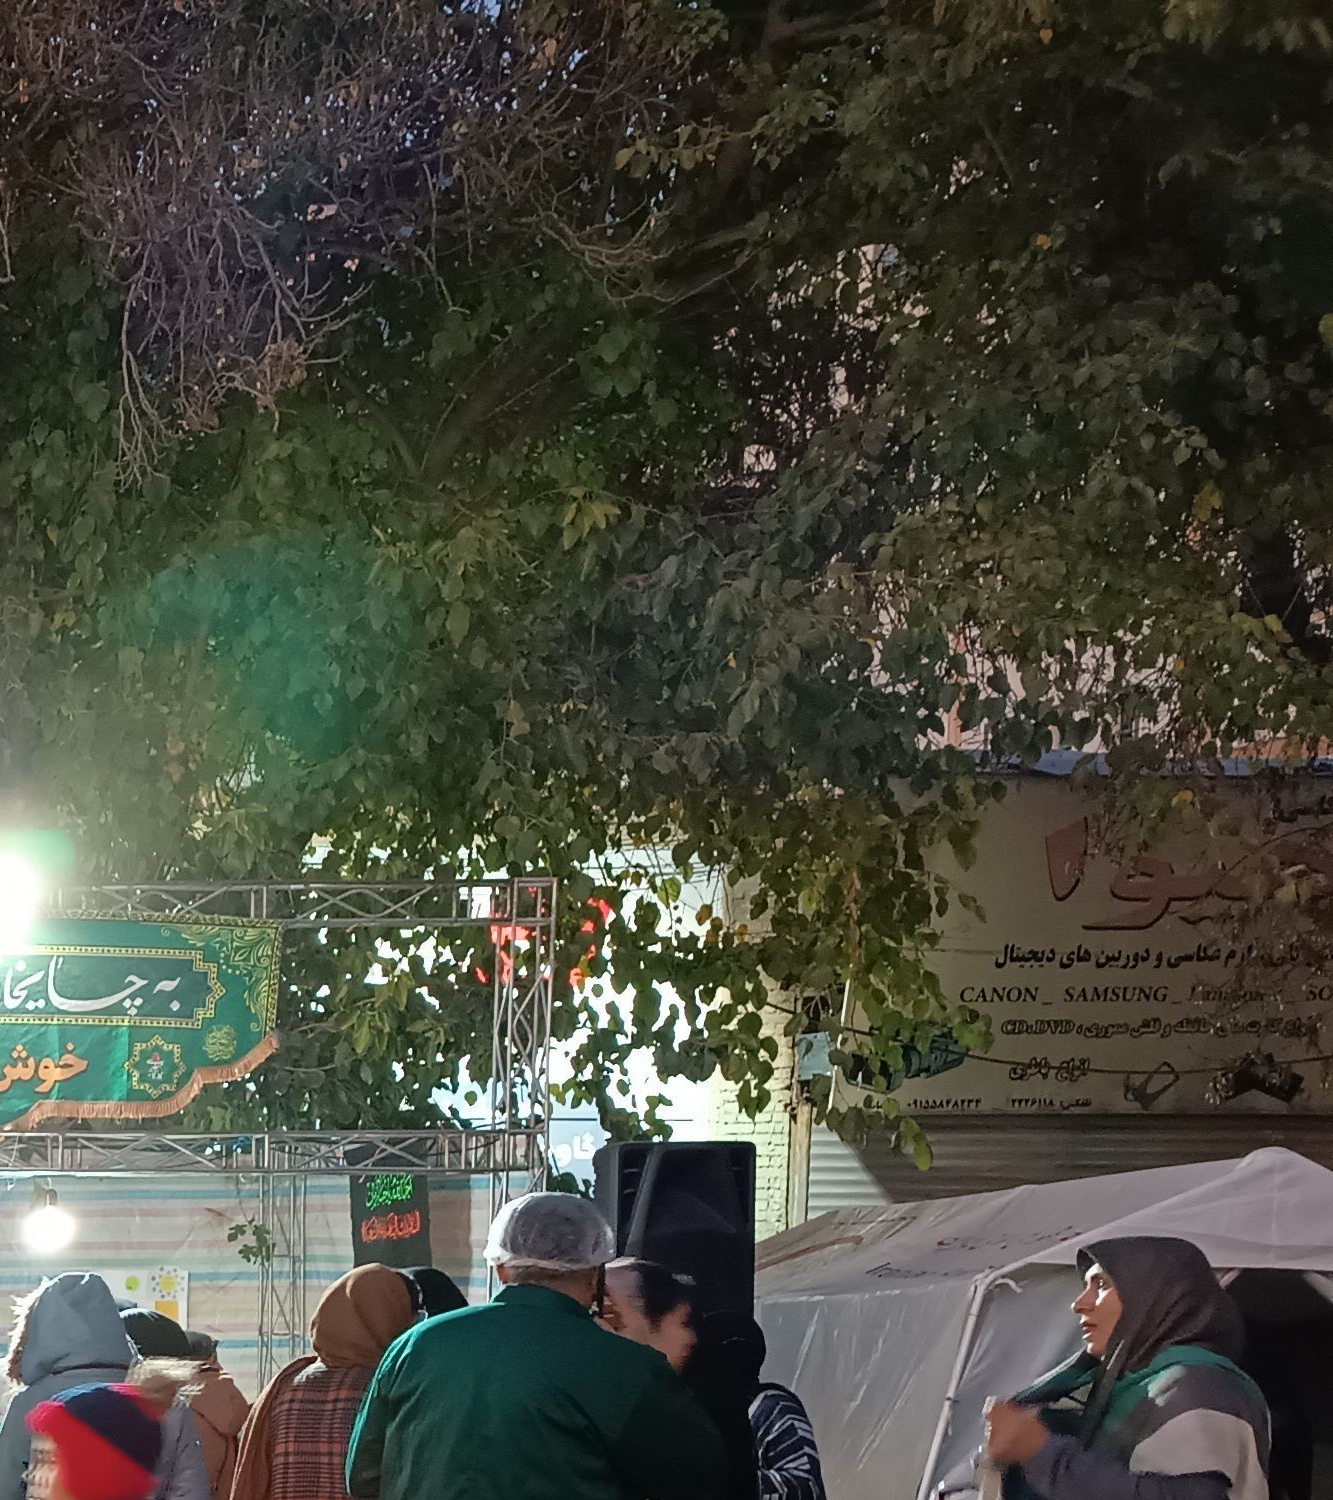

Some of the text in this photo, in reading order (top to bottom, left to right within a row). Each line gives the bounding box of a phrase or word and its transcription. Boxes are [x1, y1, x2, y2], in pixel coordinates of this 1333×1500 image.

[994, 943, 1056, 969] دیجیتال
[1059, 943, 1092, 970] های
[1095, 947, 1151, 969] دوربین
[152, 976, 182, 1012] به
[959, 986, 1040, 1003] CANON
[1063, 986, 1169, 1003] SAMSUNG
